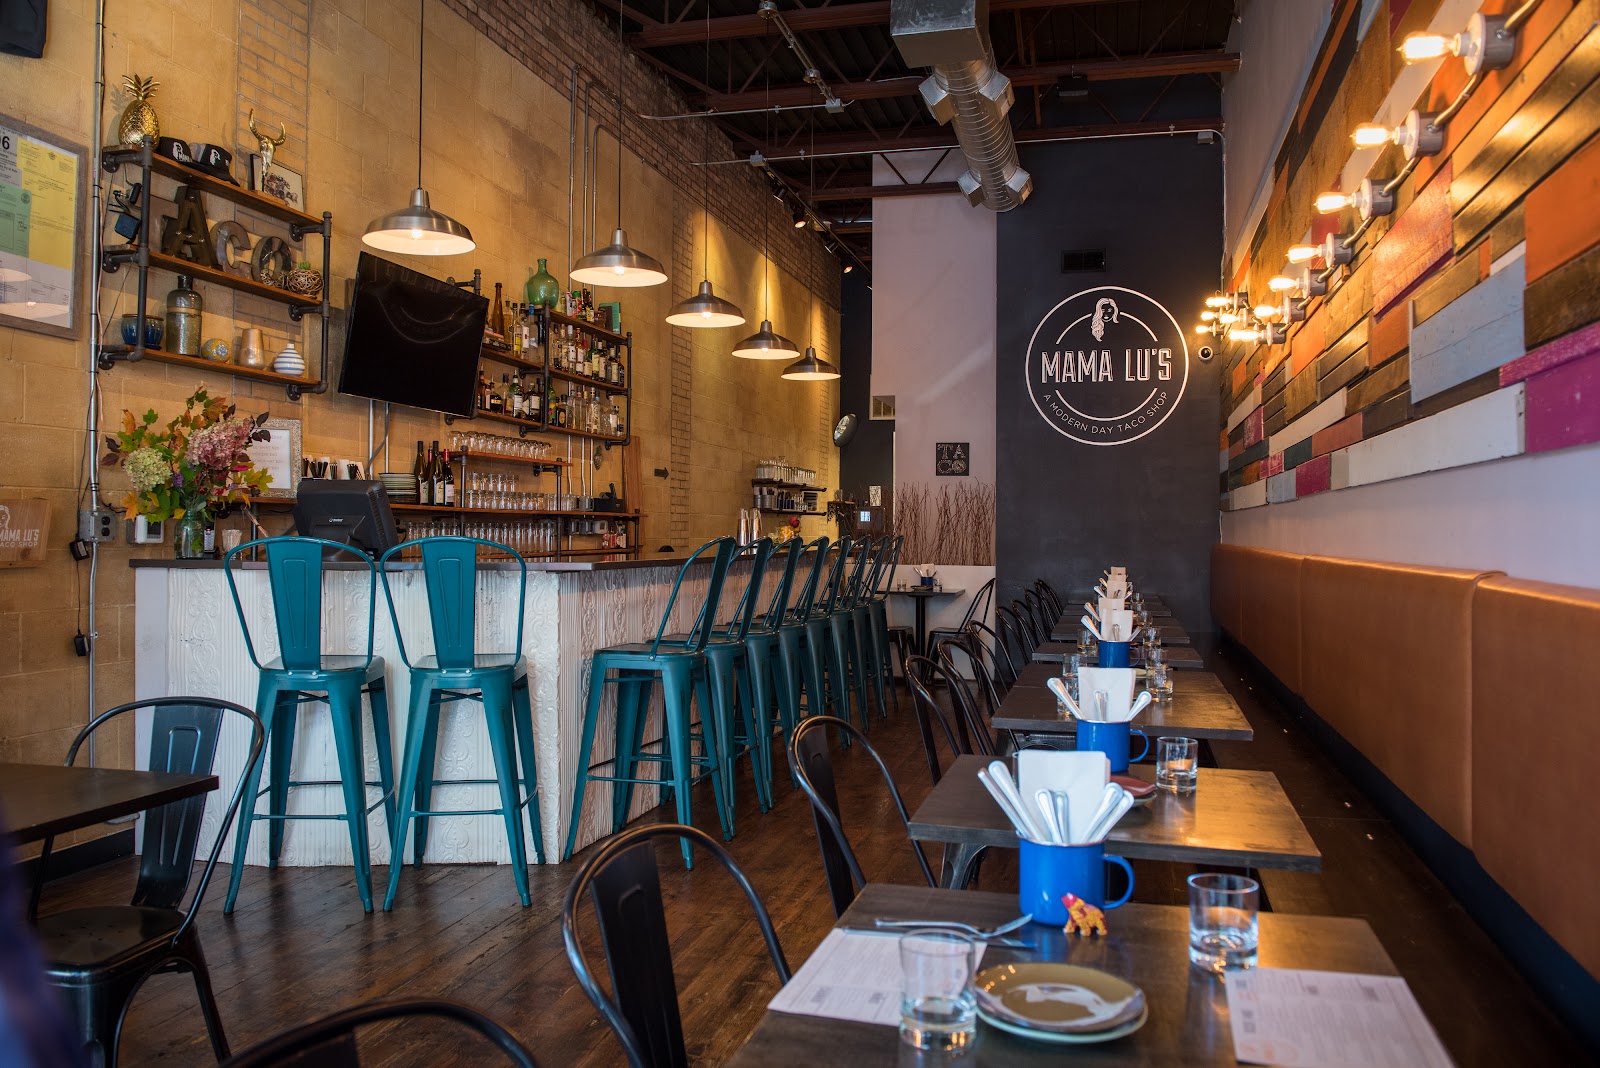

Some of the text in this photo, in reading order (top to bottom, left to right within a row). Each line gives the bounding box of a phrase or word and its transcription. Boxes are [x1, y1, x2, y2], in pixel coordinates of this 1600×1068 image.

[1041, 347, 1172, 384] MAMA LU'S
[1043, 391, 1168, 435] A MODERN DAY TACO SHOP
[23, 528, 39, 541] LU'S
